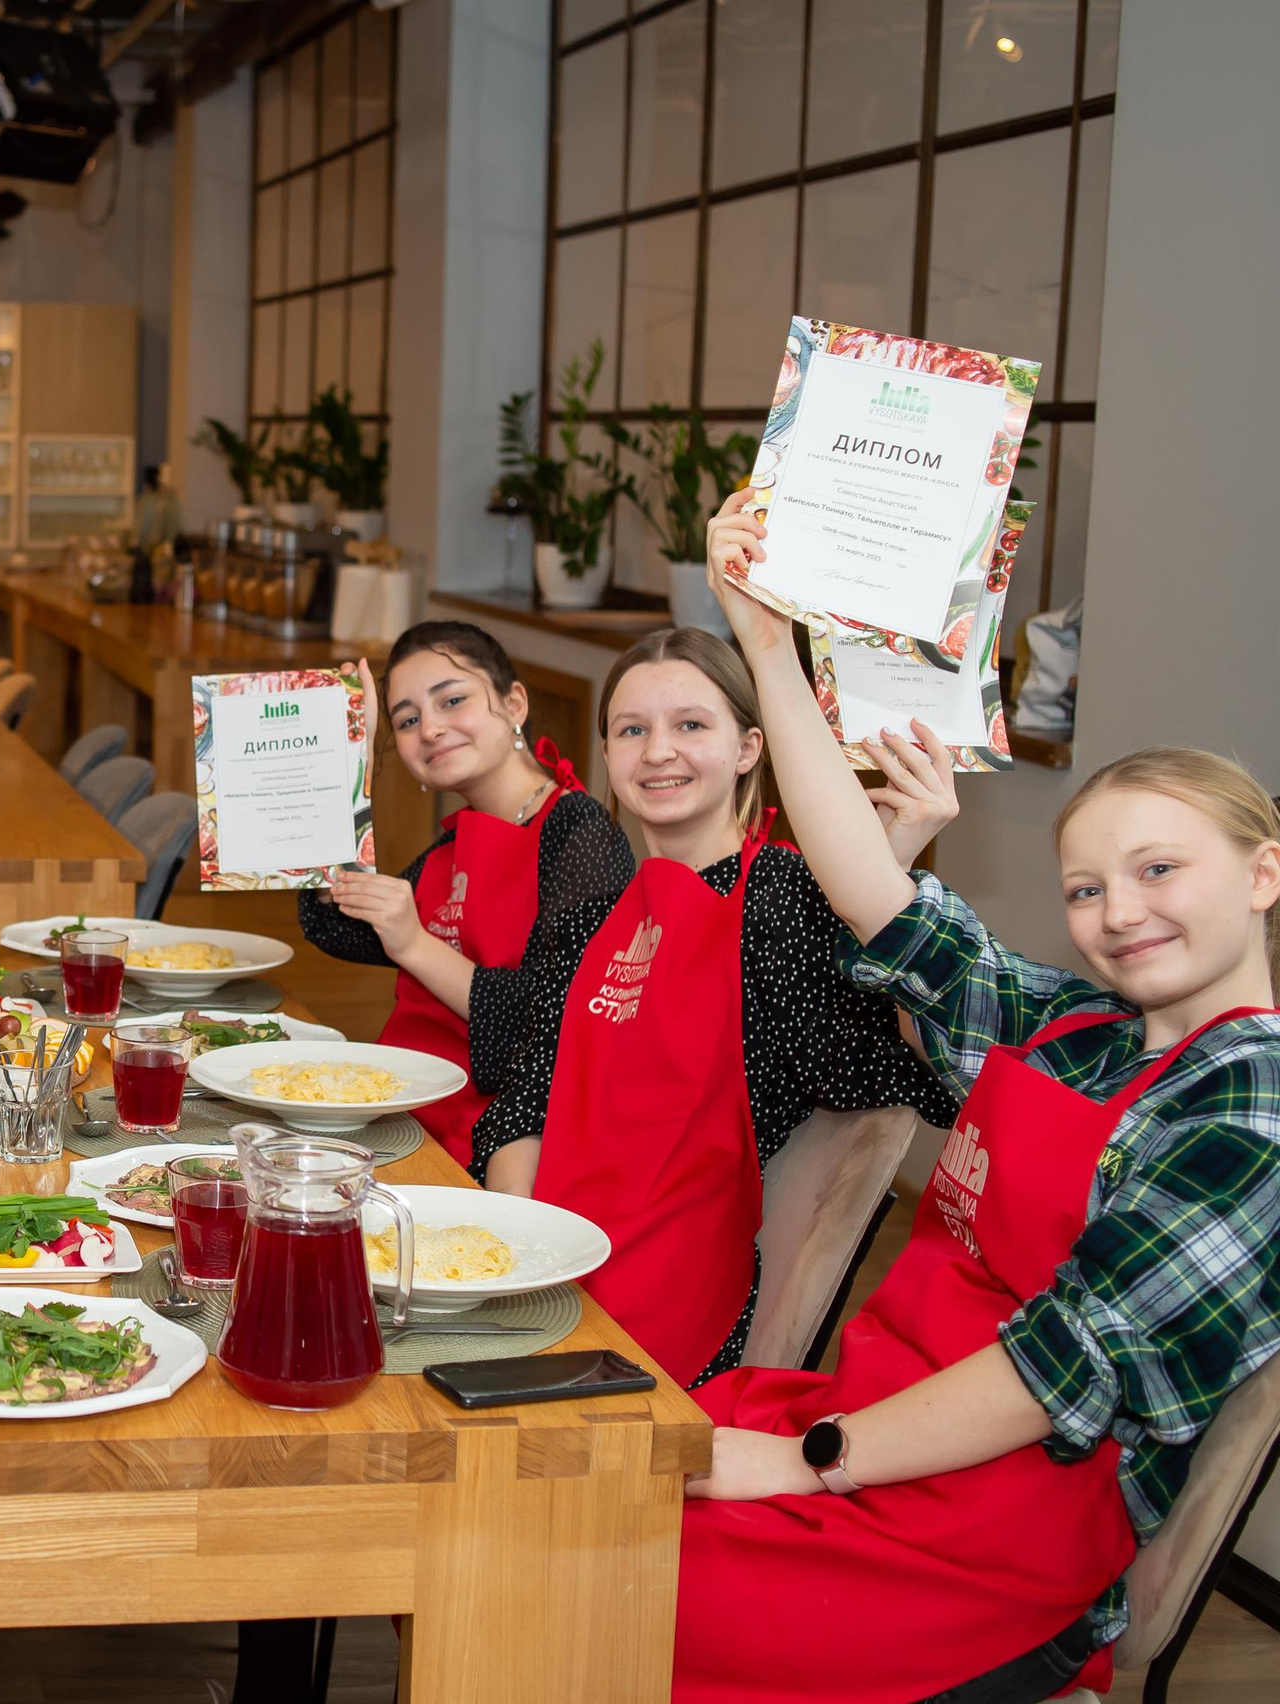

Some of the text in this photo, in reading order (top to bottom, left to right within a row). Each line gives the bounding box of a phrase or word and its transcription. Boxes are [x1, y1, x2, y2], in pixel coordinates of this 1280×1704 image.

[870, 381, 929, 414] Julia
[869, 406, 926, 425] VYSOTSKAYA
[832, 434, 942, 469] ДИПЛОМ
[822, 504, 854, 519] Тоннато,
[857, 513, 900, 530] Тальятелле
[910, 526, 951, 542] Тирамису»
[260, 701, 299, 718] Julia
[244, 735, 317, 755] ДИПЛОМ
